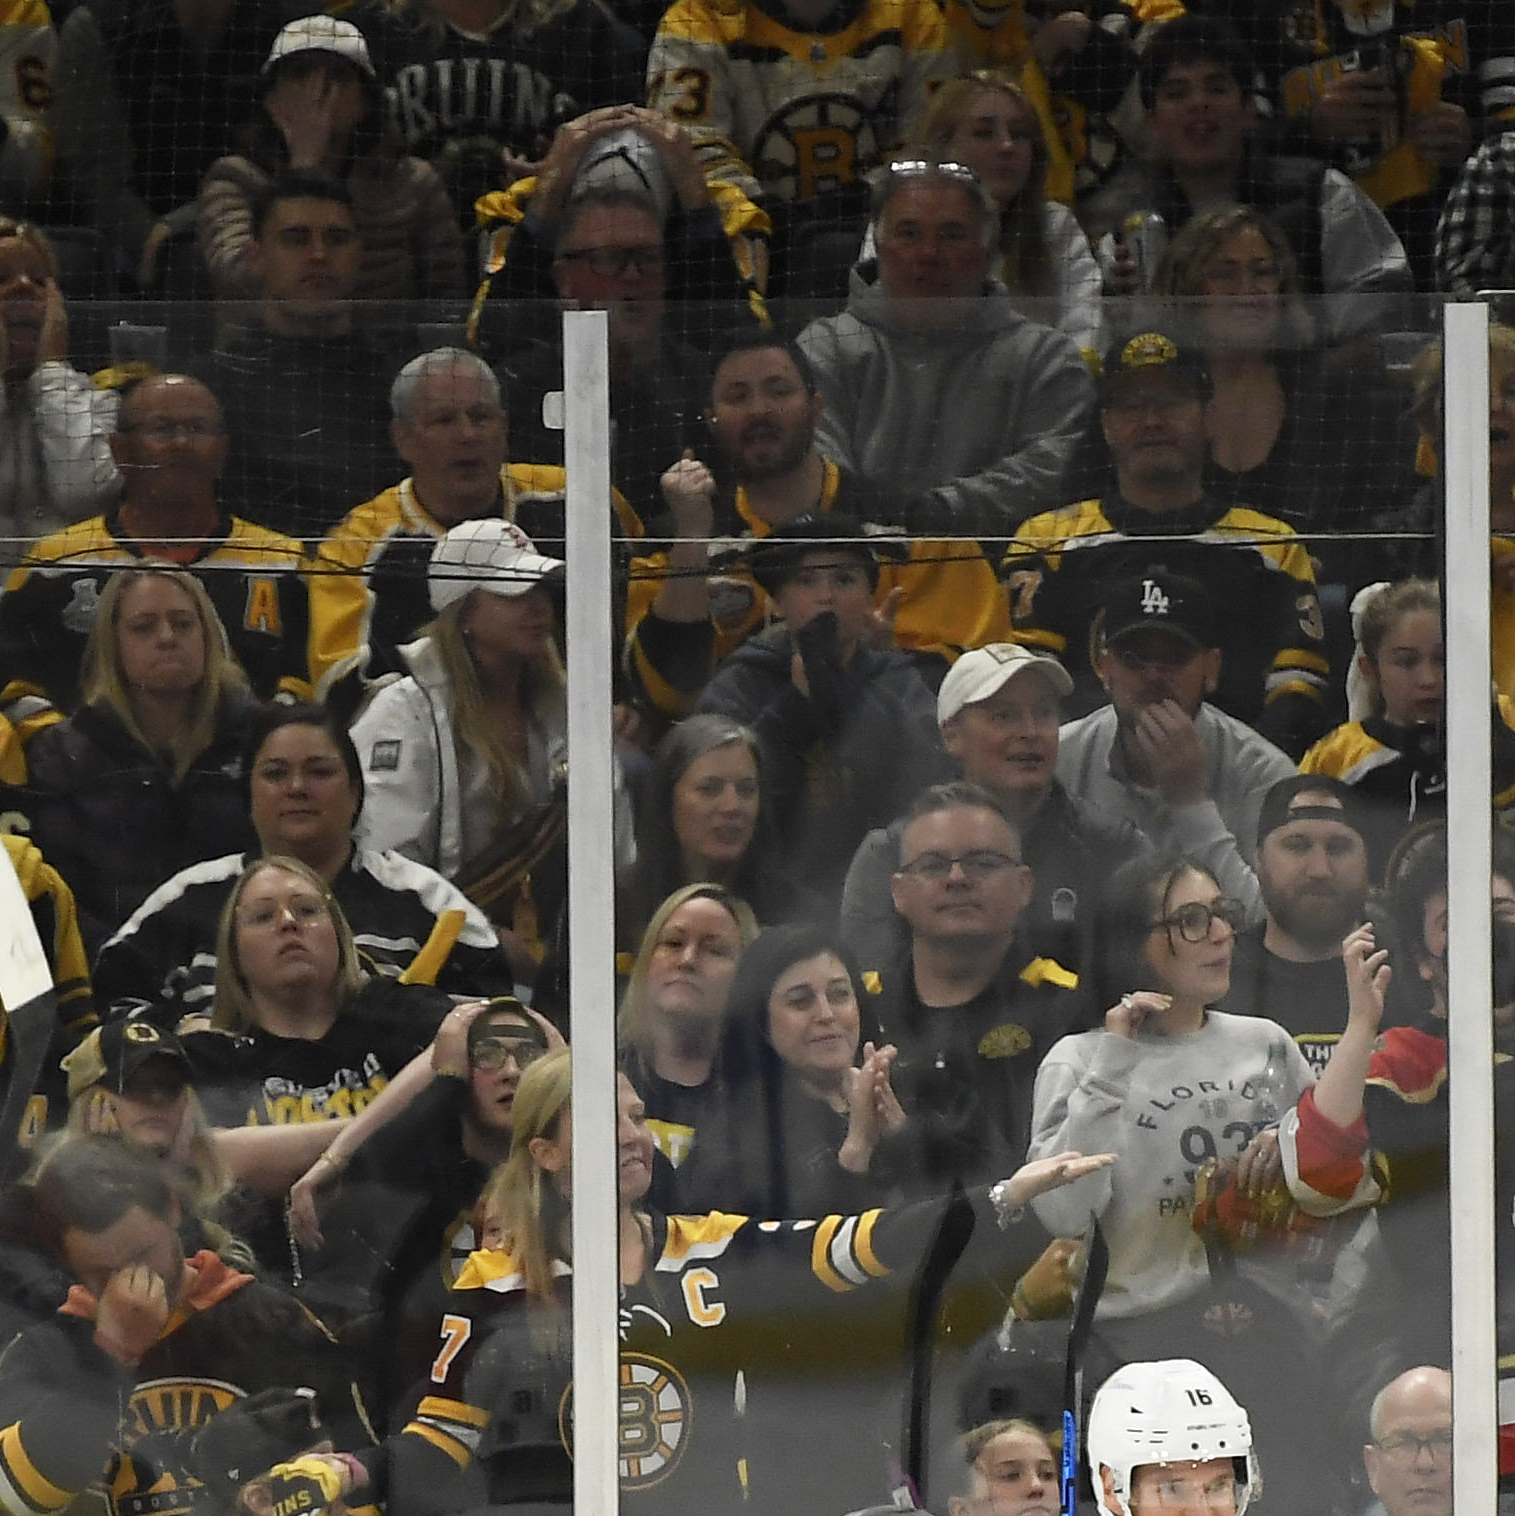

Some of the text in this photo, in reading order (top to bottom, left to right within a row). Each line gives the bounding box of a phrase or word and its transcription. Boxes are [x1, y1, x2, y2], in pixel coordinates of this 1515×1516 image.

[1139, 579, 1170, 615] LA
[1136, 1074, 1260, 1132] FLORID
[680, 1265, 726, 1328] C
[429, 1312, 473, 1385] 7
[1185, 1388, 1213, 1407] 16
